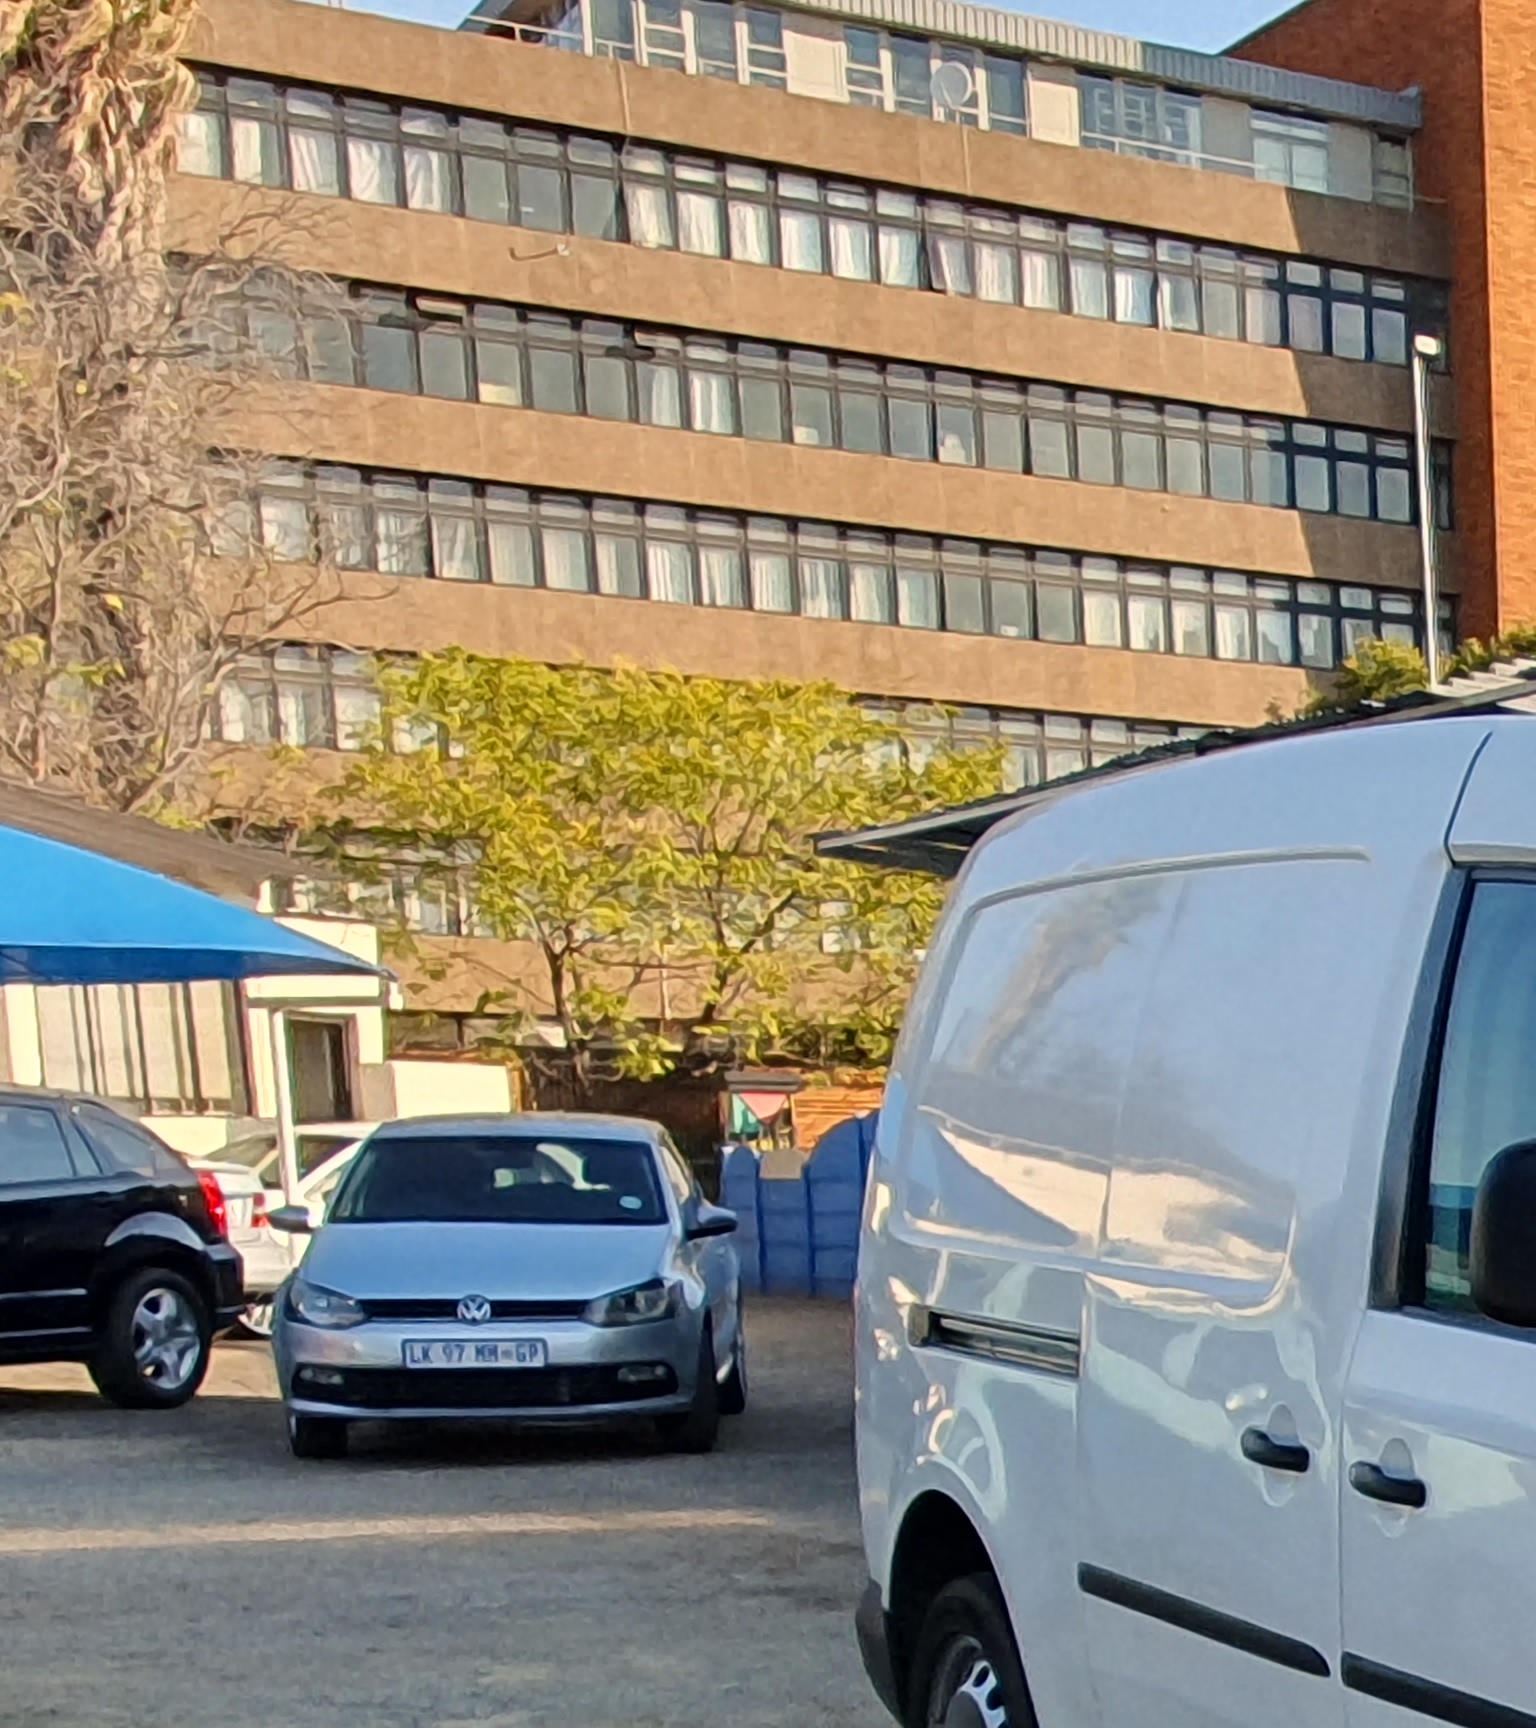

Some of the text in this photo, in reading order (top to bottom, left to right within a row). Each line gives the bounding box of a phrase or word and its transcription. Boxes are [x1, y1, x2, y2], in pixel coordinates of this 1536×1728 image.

[409, 1343, 432, 1363] LK
[442, 1343, 465, 1363] 97
[515, 1343, 539, 1363] GP
